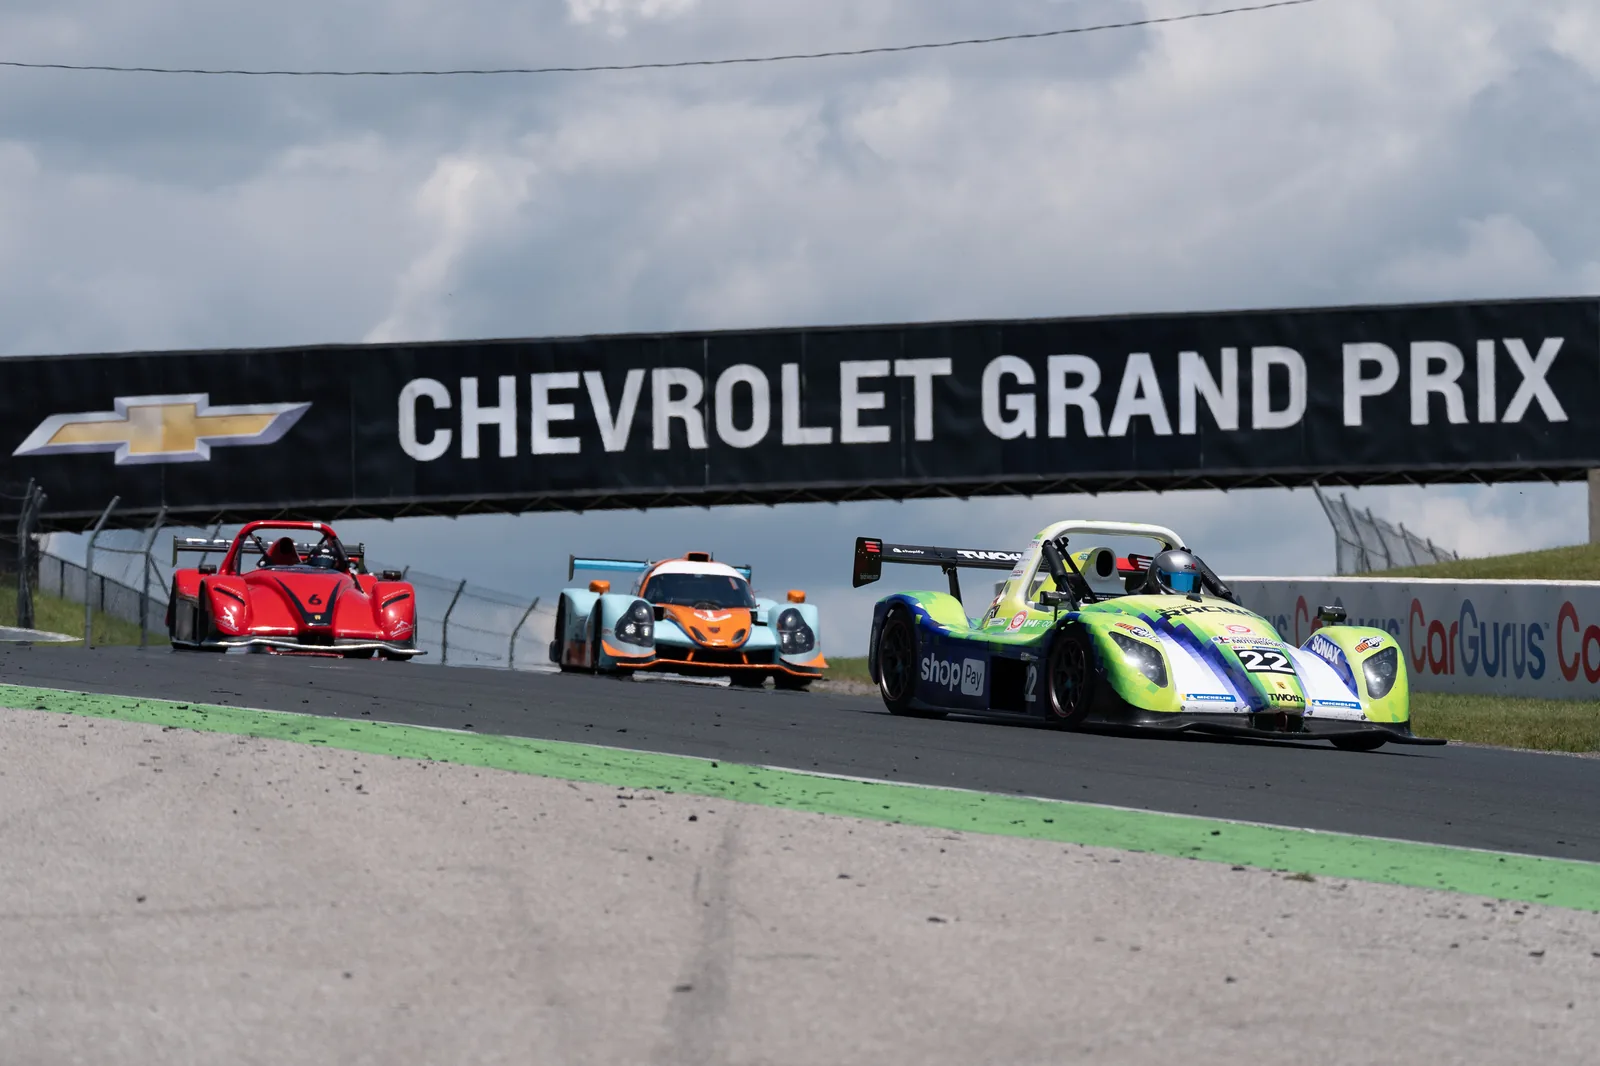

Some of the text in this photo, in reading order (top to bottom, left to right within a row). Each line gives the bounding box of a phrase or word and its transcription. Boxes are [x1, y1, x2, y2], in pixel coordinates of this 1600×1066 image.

[399, 337, 1567, 461] CHEVROLET GRAND PRIX
[308, 594, 322, 604] 6
[1312, 635, 1341, 665] SONAX
[1410, 598, 1546, 680] CarGurus
[920, 653, 982, 691] shop Pay
[1239, 651, 1295, 673] 22
[1269, 693, 1303, 703] TWOth
